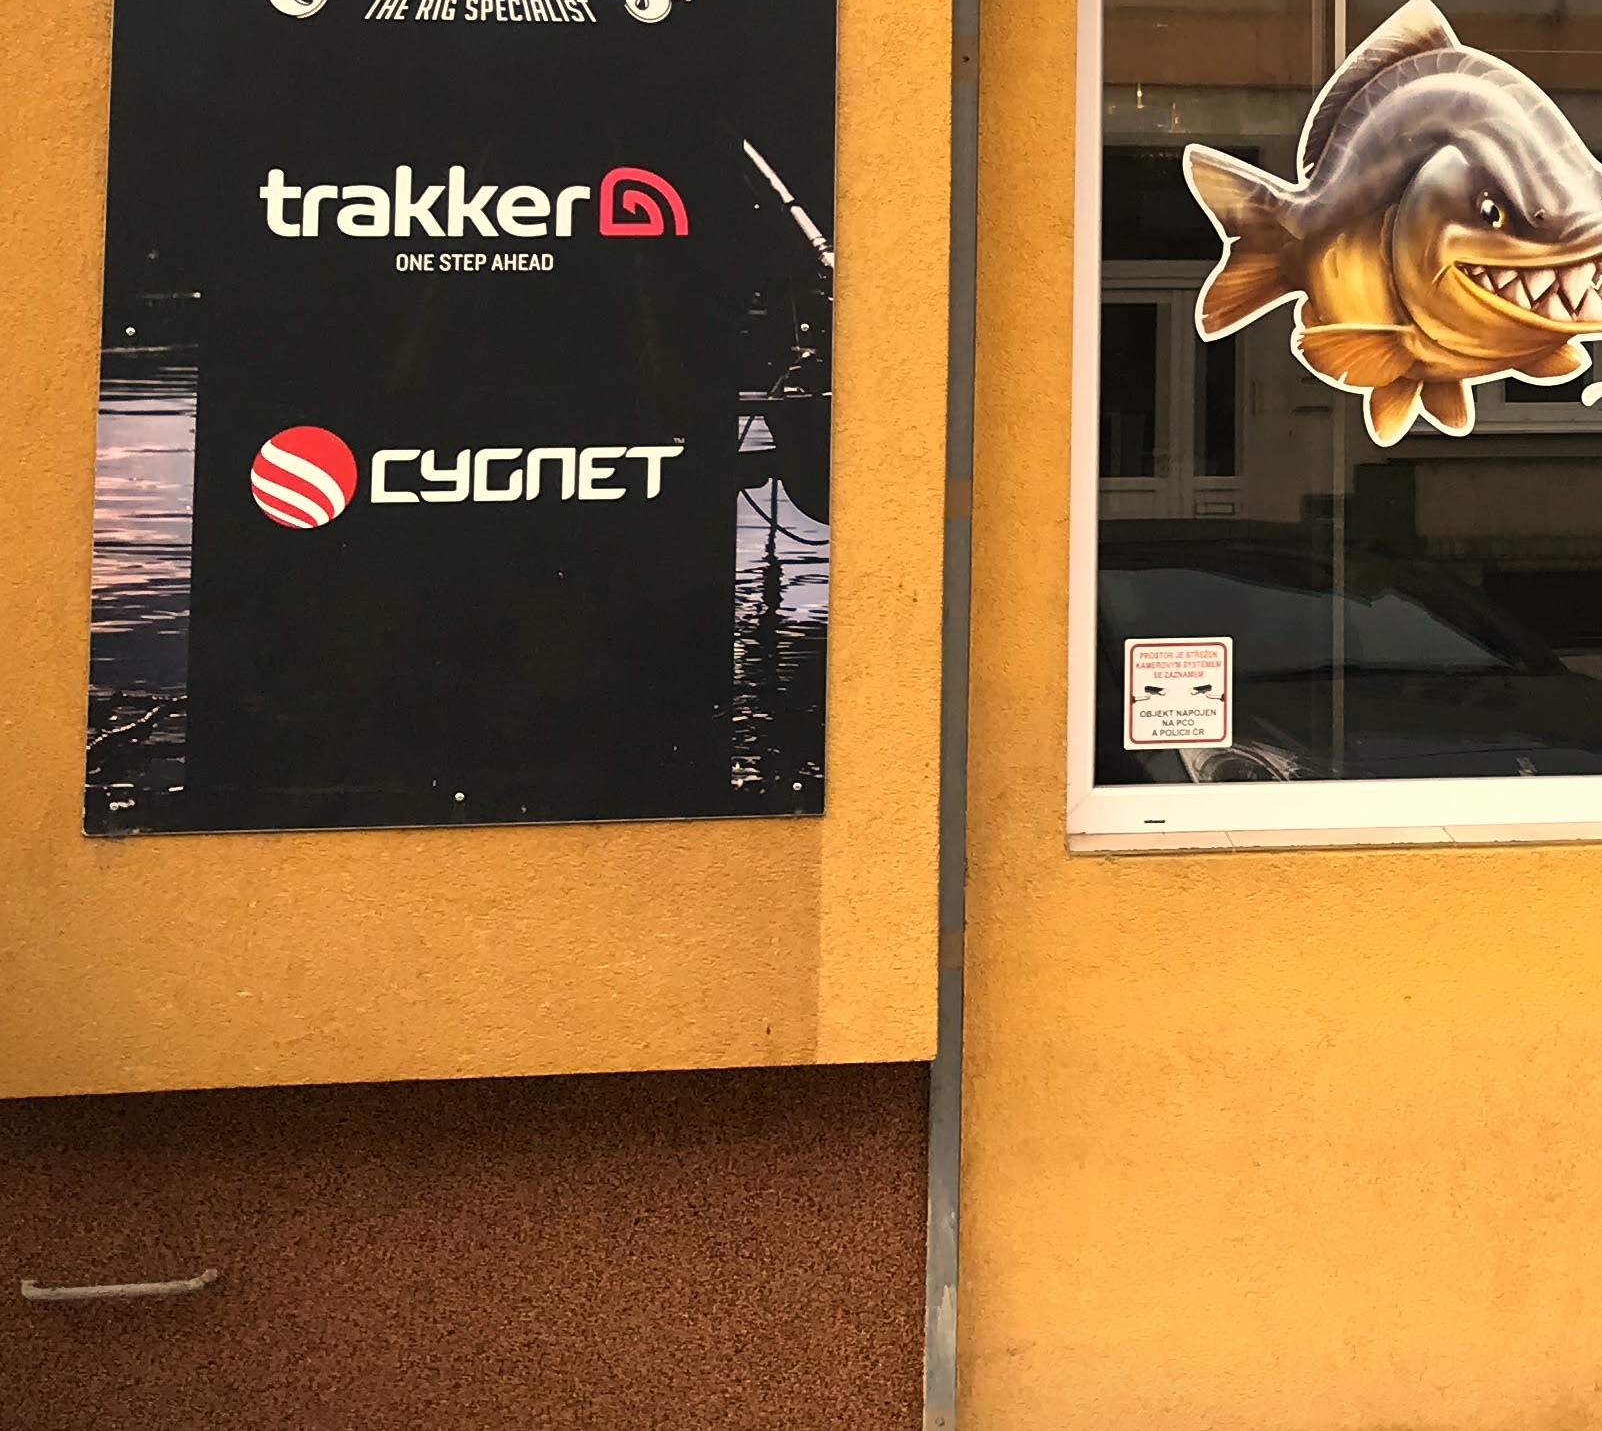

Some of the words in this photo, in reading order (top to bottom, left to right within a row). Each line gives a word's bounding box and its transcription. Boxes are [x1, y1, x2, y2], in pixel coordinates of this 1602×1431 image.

[260, 165, 591, 237] trakker
[395, 253, 435, 272] ONE
[438, 253, 487, 272] STEP
[491, 253, 554, 272] AHEAD
[371, 445, 686, 503] CYGNET
[1139, 651, 1174, 659] PROSTOR
[1175, 651, 1184, 659] JE
[1153, 671, 1162, 679] SE
[1139, 710, 1174, 718] OBJEKT
[1176, 709, 1217, 717] NAPOJEN
[1162, 719, 1174, 727] NA
[1176, 719, 1194, 727] PCO
[1160, 729, 1190, 737] POLICII
[1192, 727, 1205, 736] ČR
